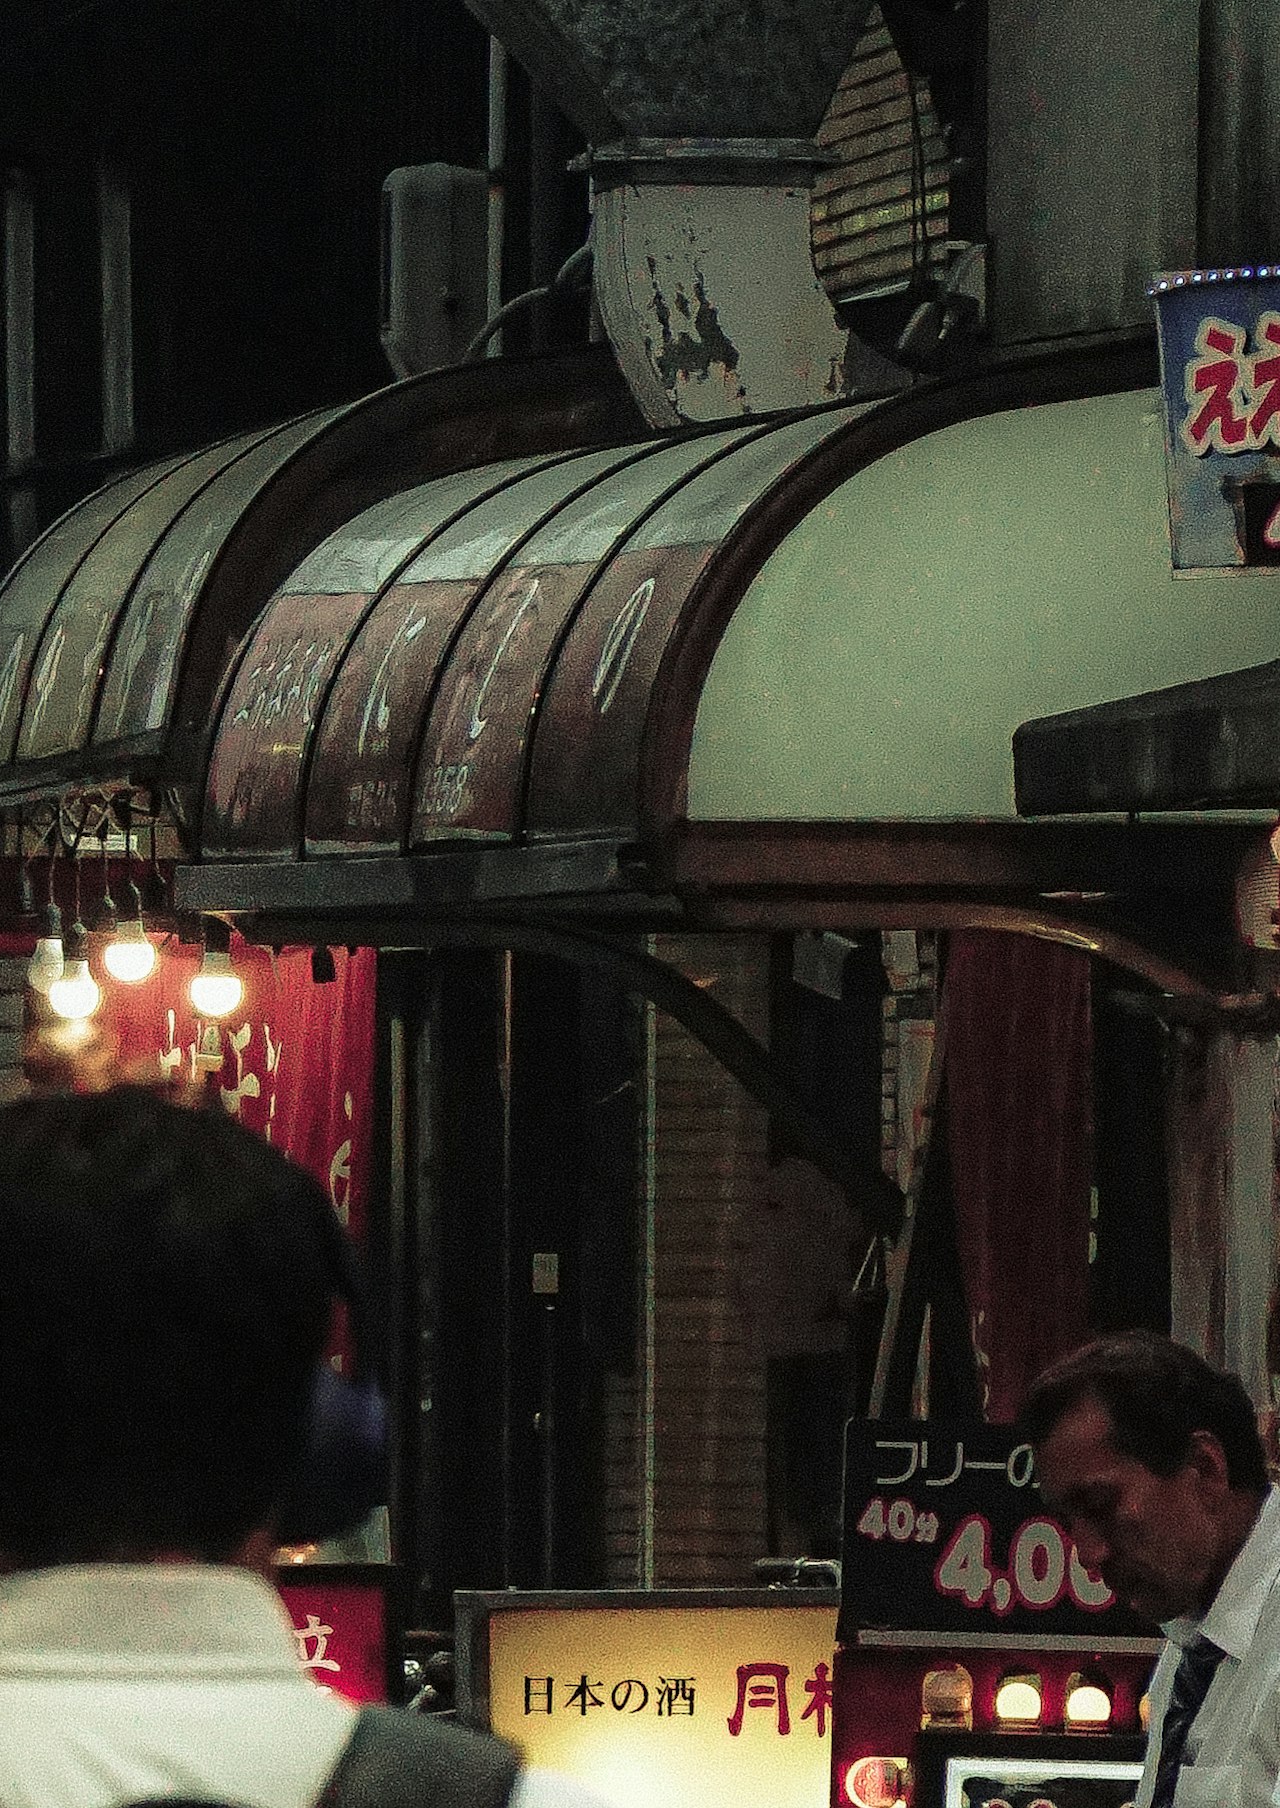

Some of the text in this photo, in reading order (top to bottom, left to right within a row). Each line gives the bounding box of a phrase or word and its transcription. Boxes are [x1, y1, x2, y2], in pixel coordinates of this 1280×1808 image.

[857, 1497, 939, 1543] 40分
[521, 1674, 697, 1717] 日本の酒
